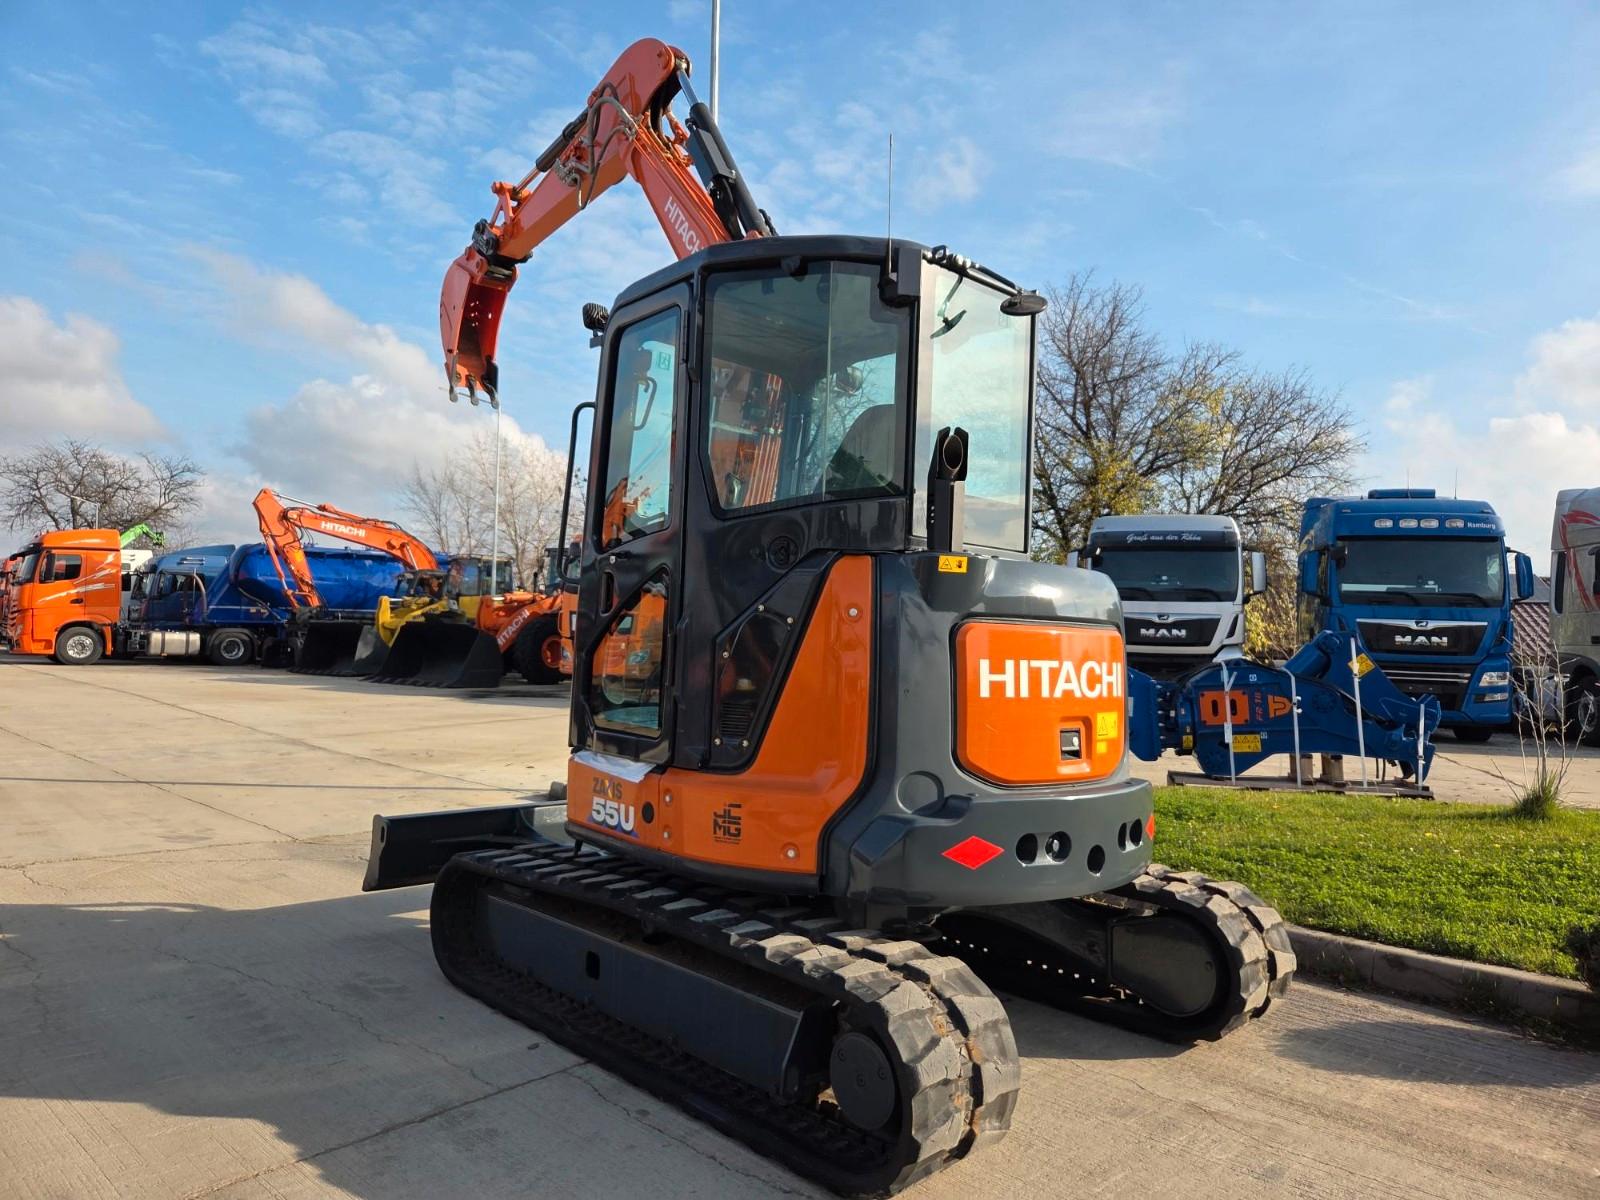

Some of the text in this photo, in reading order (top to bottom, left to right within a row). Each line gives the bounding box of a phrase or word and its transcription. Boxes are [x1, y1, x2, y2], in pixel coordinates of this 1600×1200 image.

[664, 196, 704, 255] HITACH
[320, 520, 367, 538] HITACHI
[1140, 628, 1187, 638] MAN
[1394, 635, 1448, 647] MAN
[979, 658, 1122, 699] HITACHI
[592, 776, 623, 800] ZAXIS
[591, 796, 635, 832] 55U
